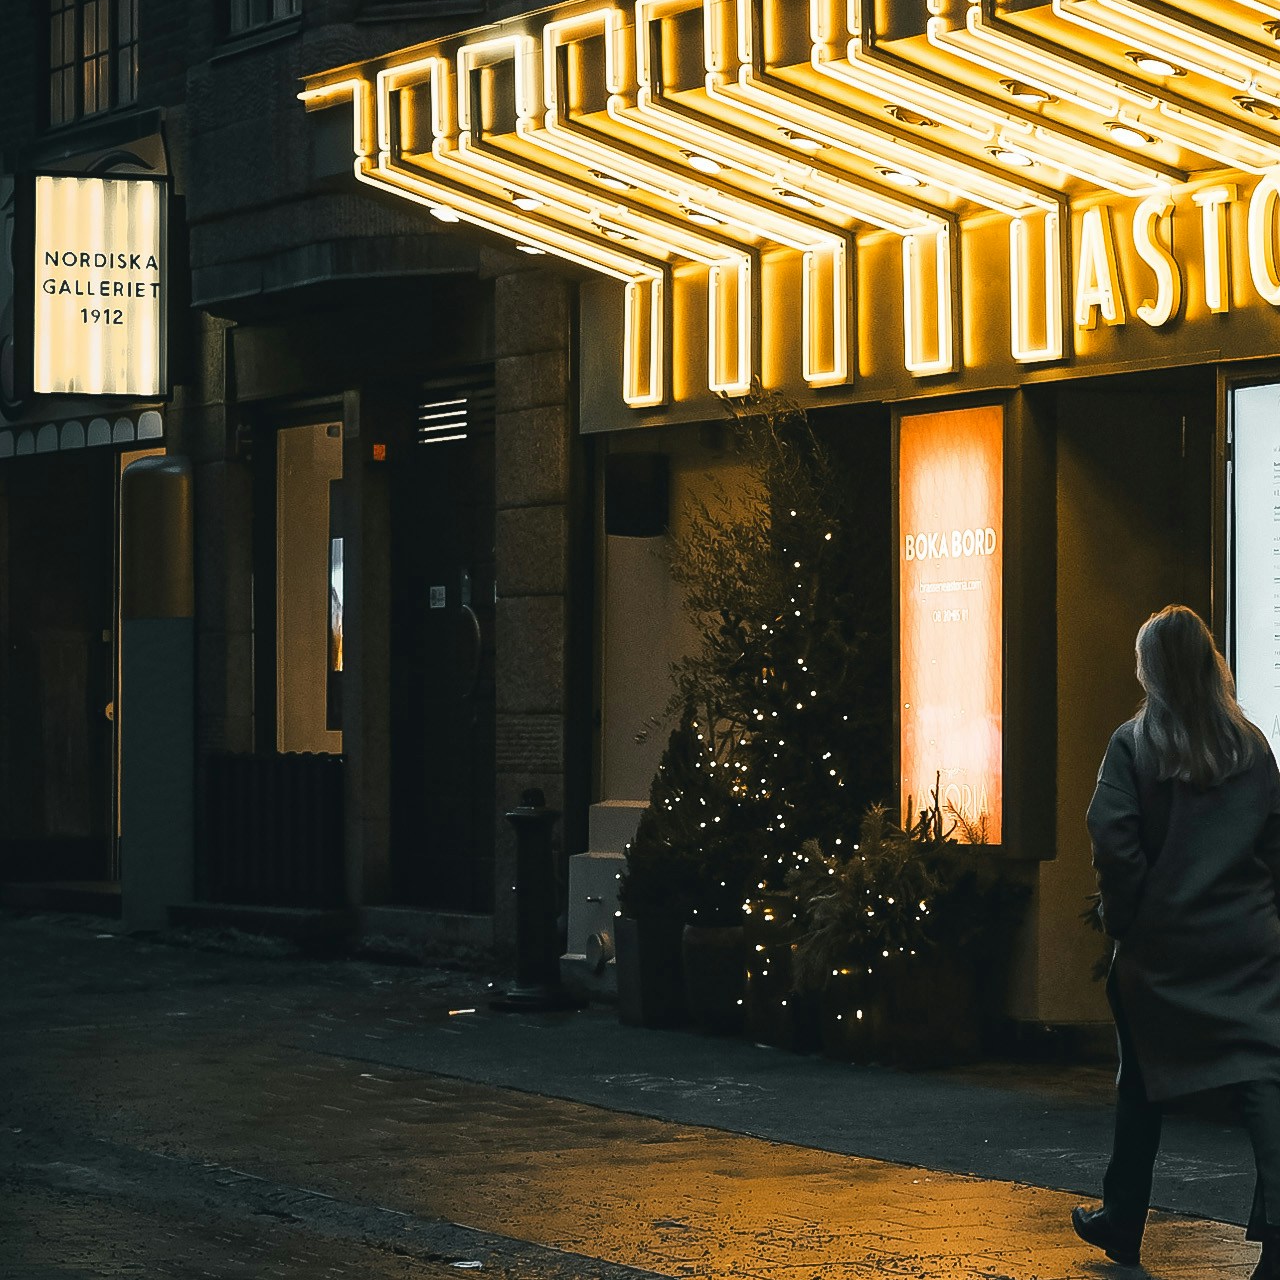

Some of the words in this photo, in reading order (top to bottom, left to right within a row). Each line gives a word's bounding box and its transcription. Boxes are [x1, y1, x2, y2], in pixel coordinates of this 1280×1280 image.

[45, 251, 159, 271] NORDISKA
[42, 279, 160, 298] GALLERIET
[81, 308, 124, 325] 1912
[905, 532, 949, 561] BOKA
[951, 527, 997, 558] BORD
